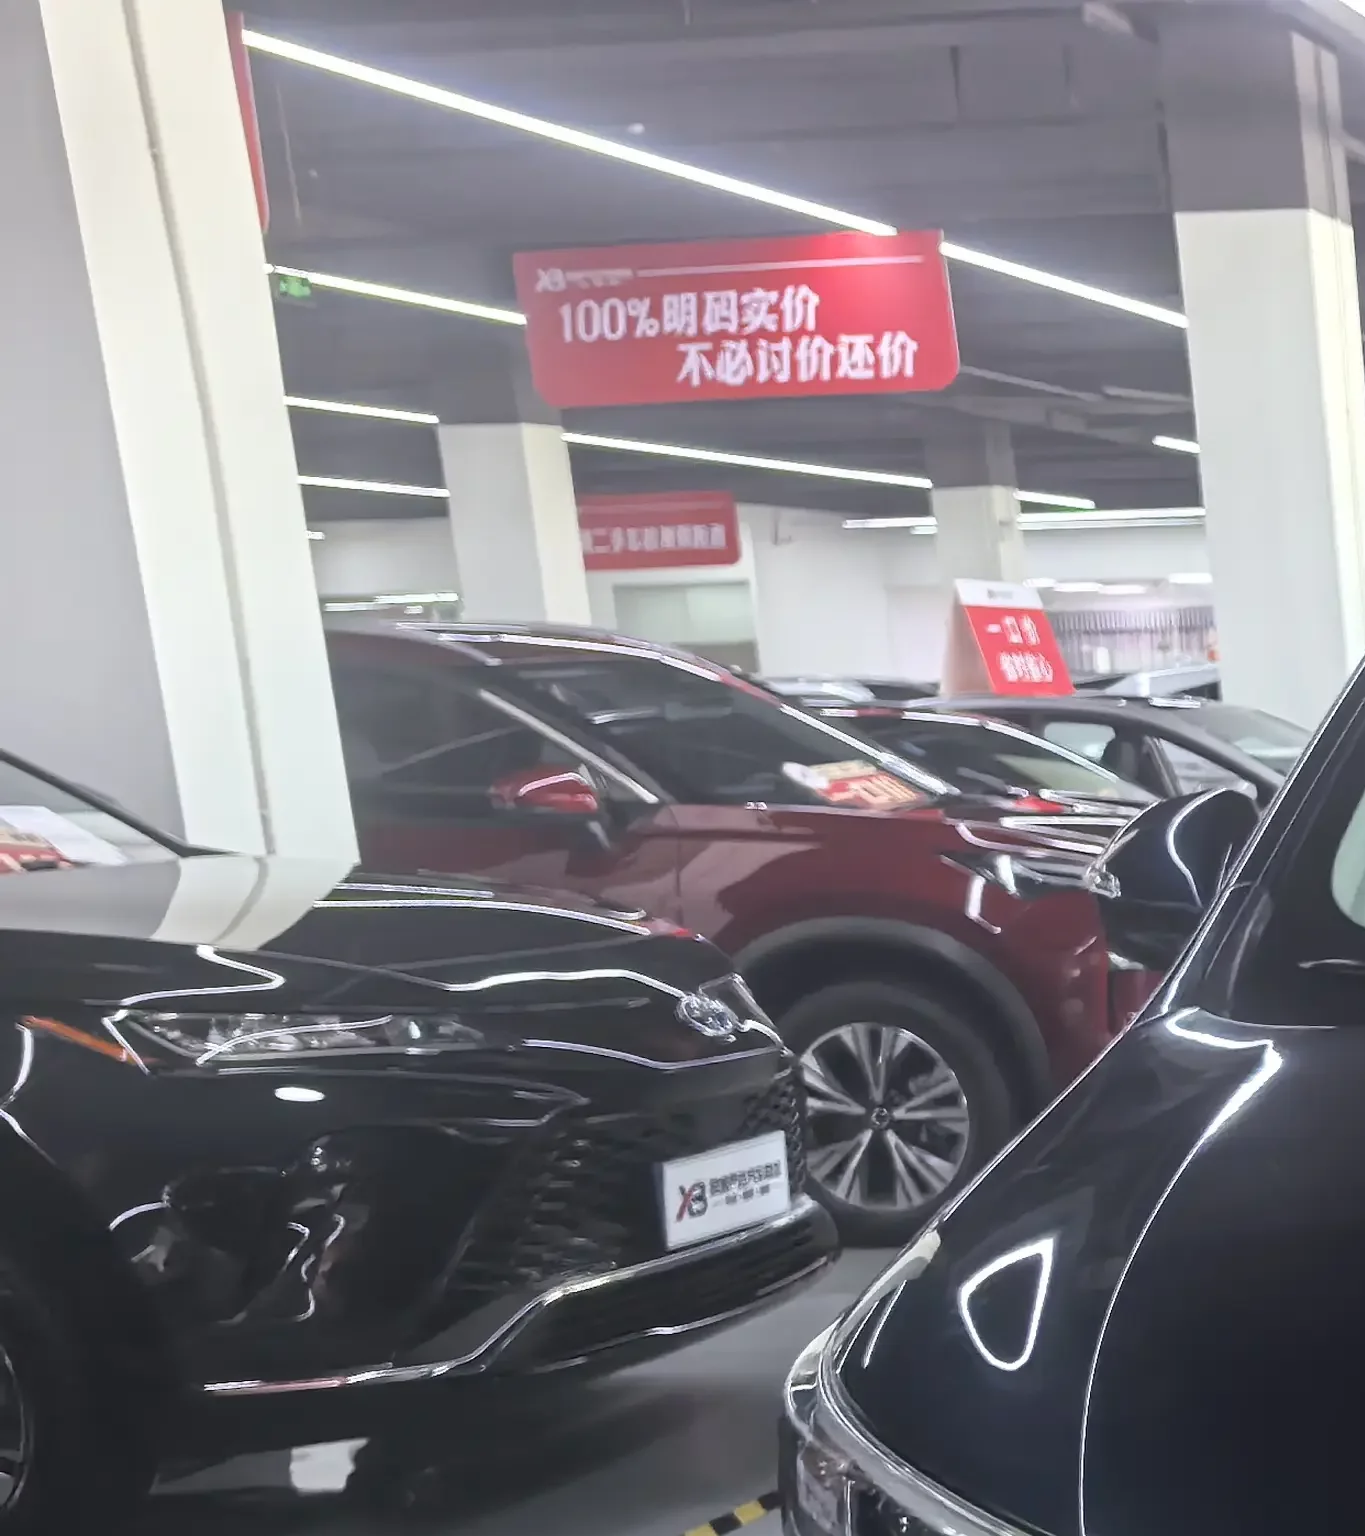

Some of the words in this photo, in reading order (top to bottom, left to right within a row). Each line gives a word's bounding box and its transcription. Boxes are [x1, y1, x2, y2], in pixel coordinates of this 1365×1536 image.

[559, 284, 820, 343] 100%明码实价
[675, 330, 919, 388] 不必讨价还价
